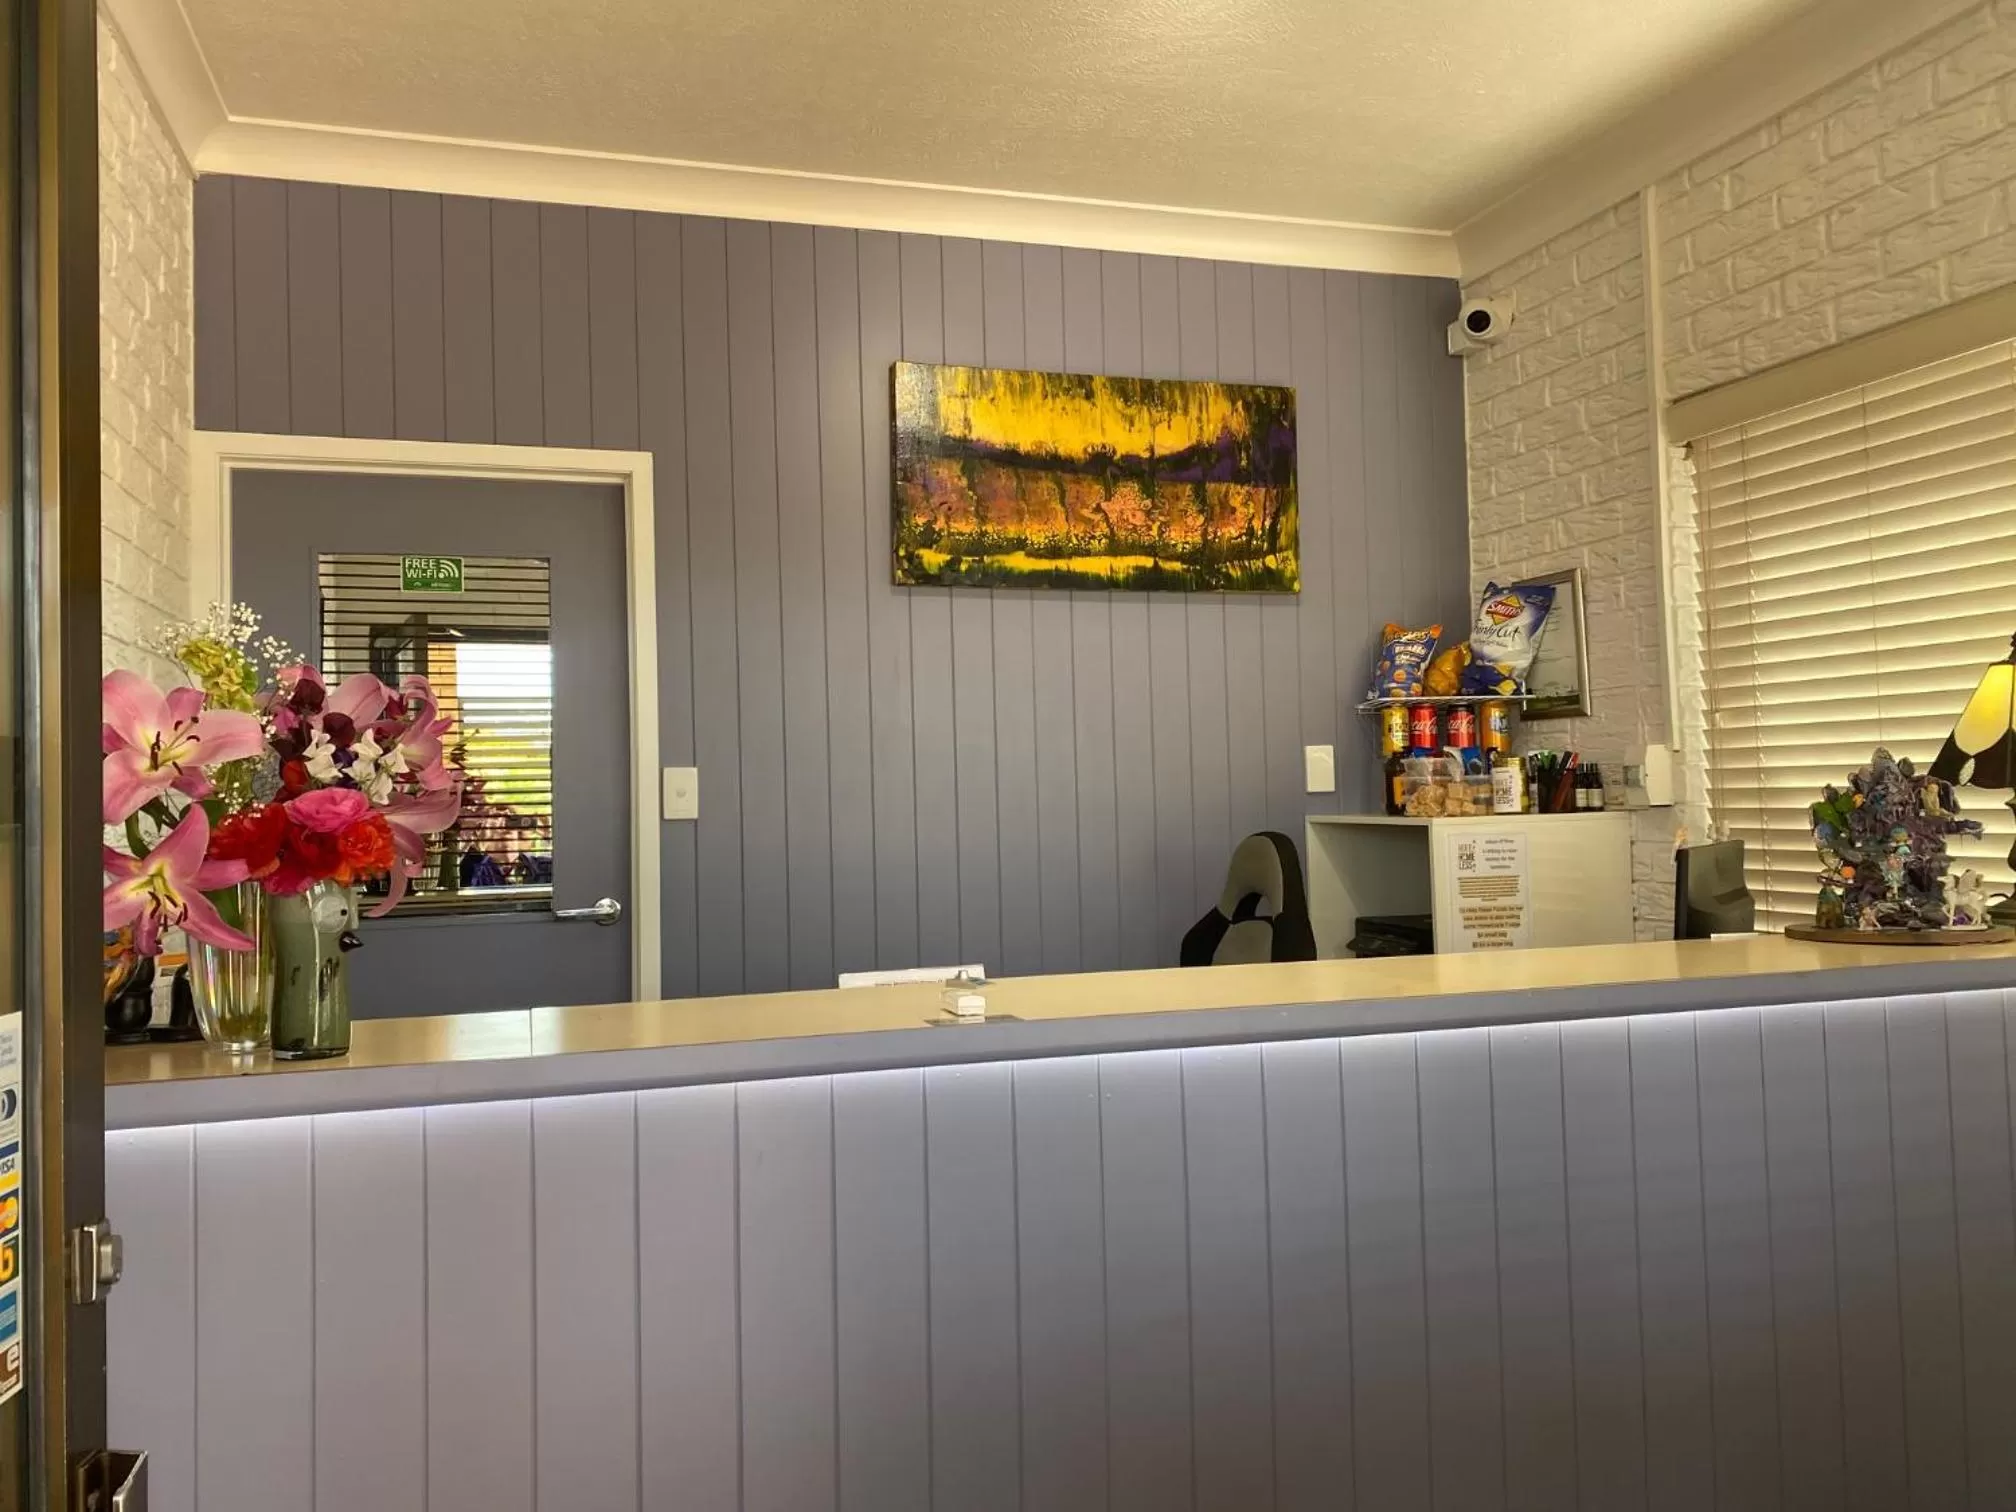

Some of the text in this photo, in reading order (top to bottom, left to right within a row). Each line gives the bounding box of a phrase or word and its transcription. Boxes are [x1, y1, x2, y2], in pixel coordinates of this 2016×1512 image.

[405, 558, 437, 569] FREE
[405, 569, 437, 578] WI-FI
[1496, 623, 1521, 640] Cut
